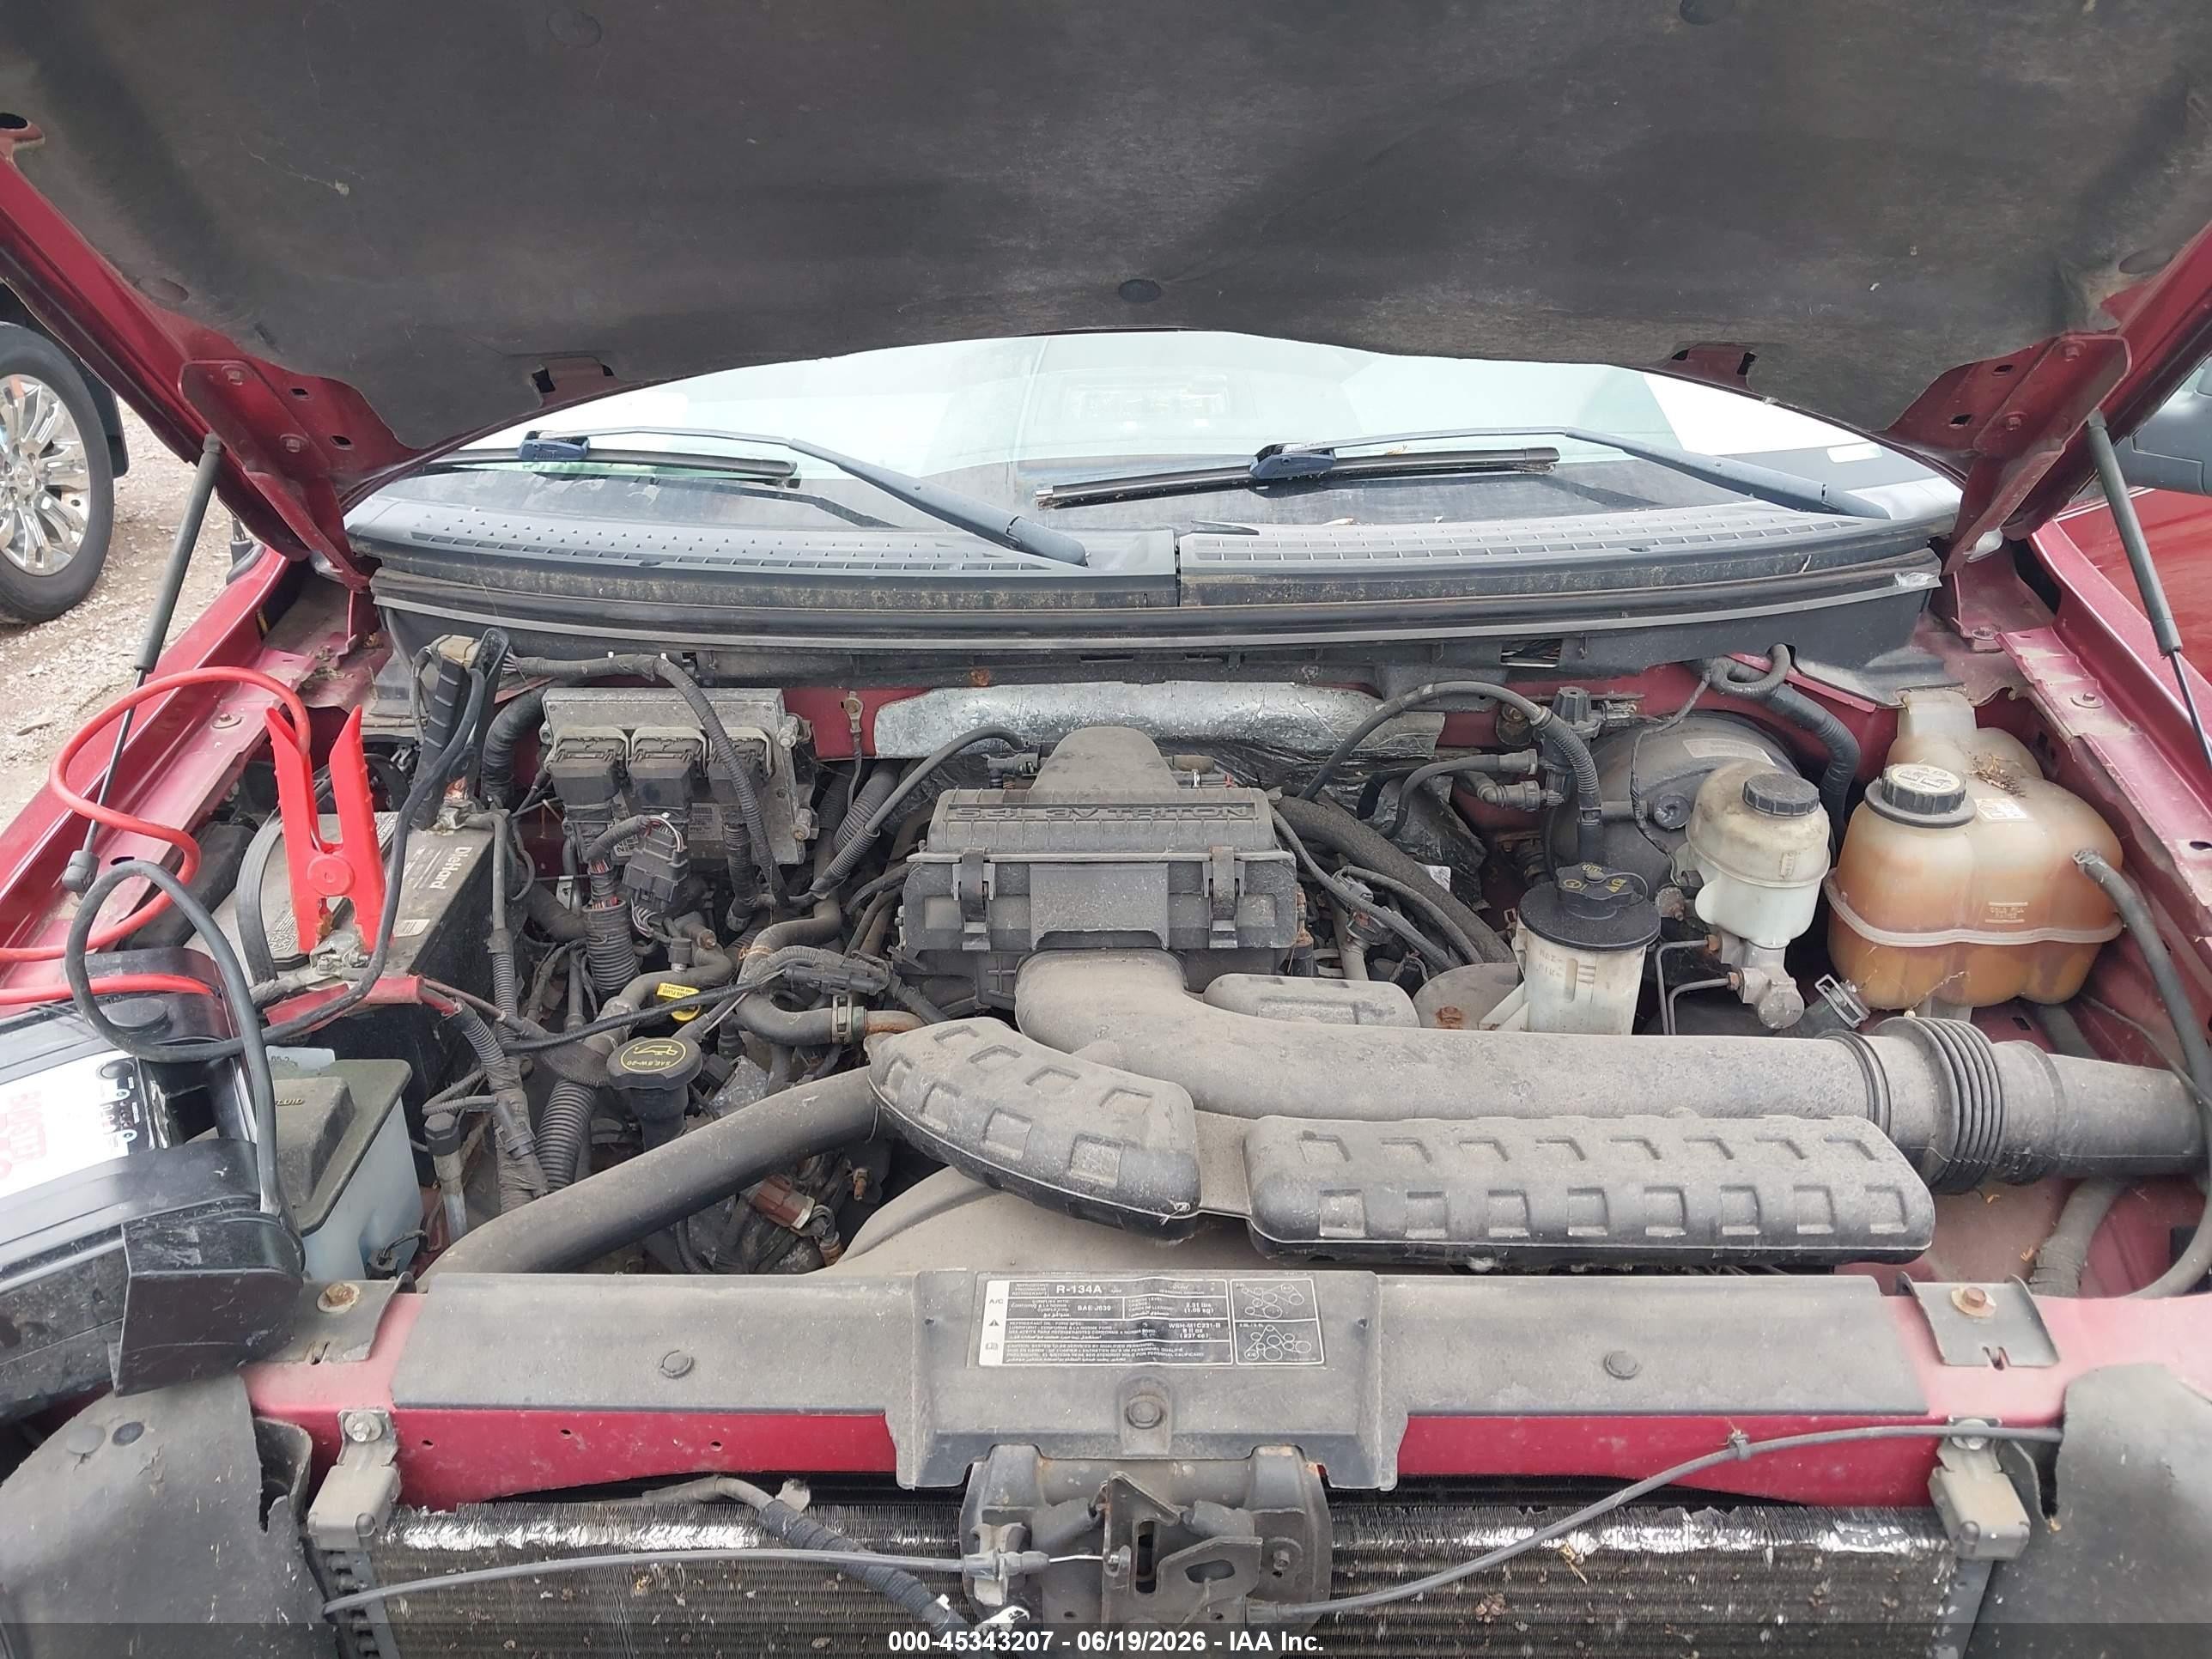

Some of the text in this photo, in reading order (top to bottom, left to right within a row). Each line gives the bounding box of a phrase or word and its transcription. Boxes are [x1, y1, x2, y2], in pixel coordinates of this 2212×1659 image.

[956, 806, 1247, 818] 5.4L 3V TRITON
[428, 846, 474, 890] DieHard
[1056, 1285, 1103, 1294] R-134A
